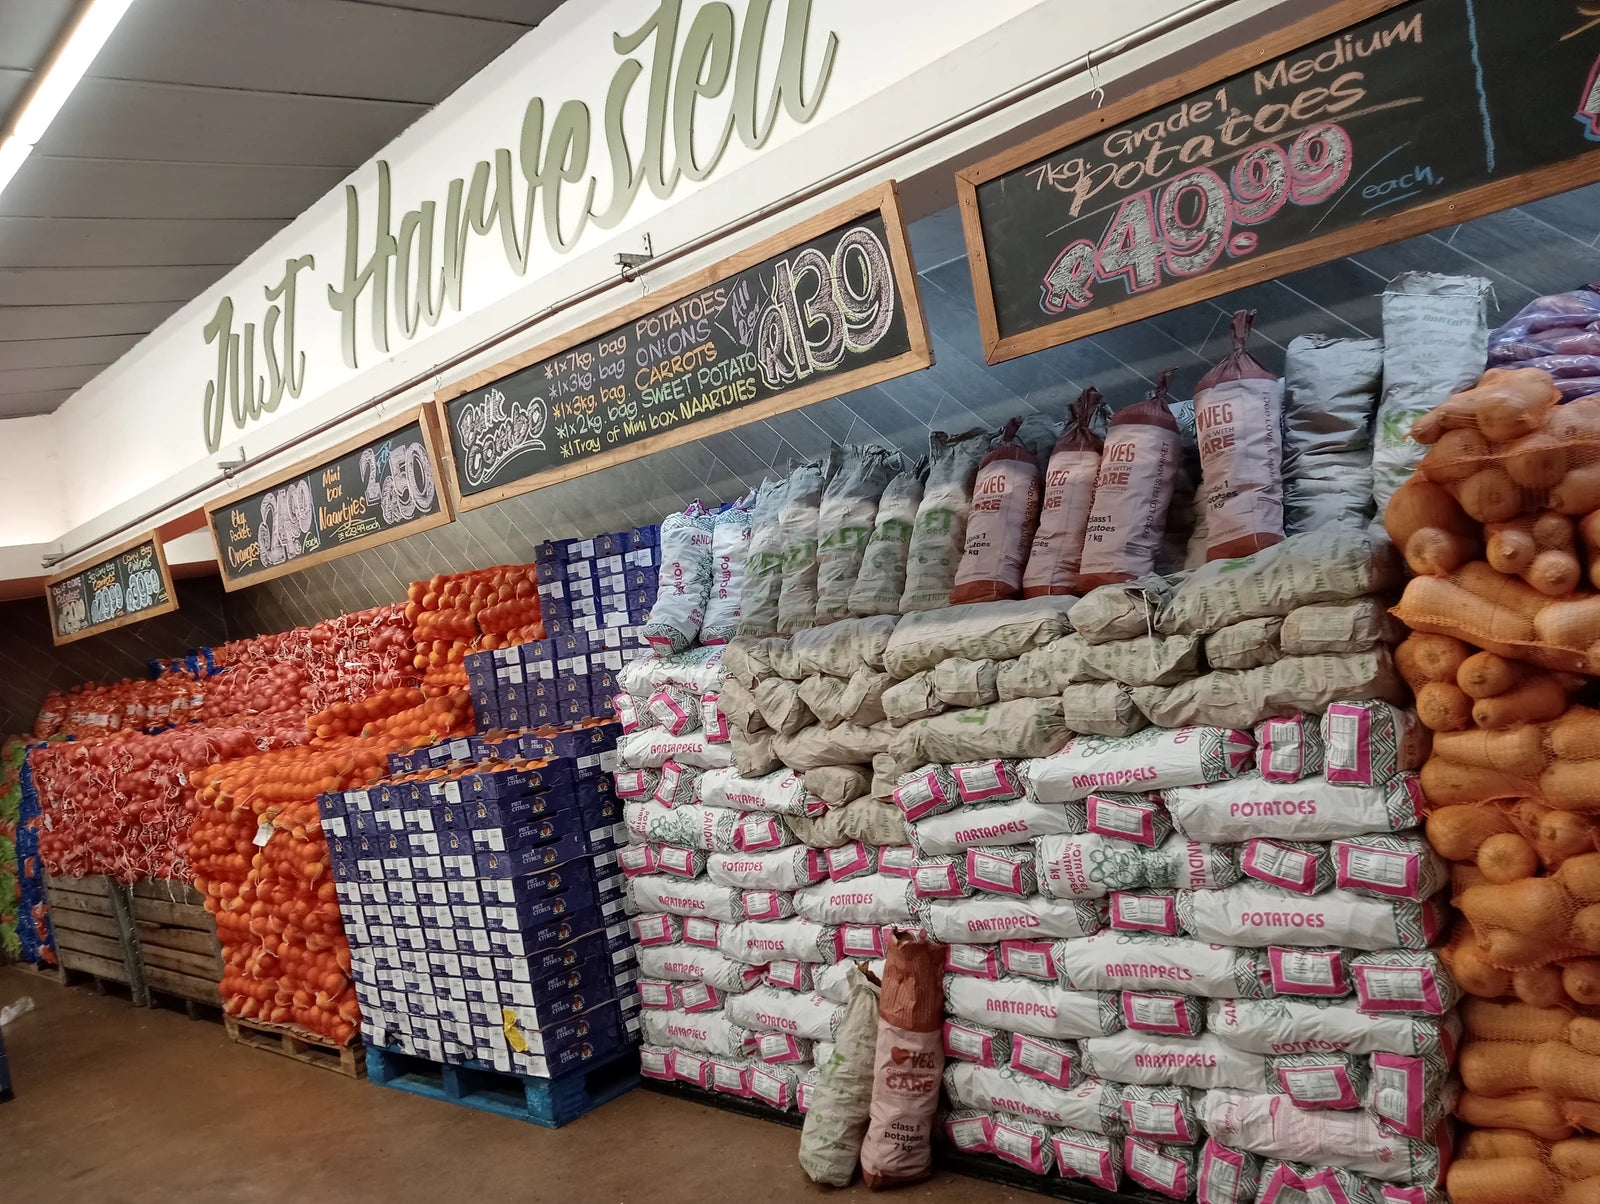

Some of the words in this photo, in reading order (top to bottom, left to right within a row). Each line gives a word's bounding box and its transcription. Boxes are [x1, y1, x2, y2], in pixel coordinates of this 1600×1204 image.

[1253, 13, 1424, 95] Medium
[1039, 122, 1354, 313] R49.99
[757, 226, 895, 390] R139
[598, 335, 627, 357] bag
[635, 287, 728, 341] POTATOES
[203, 254, 315, 454] Just
[599, 358, 626, 380] bag
[634, 341, 718, 391] CARROTS
[607, 401, 638, 422] bag
[641, 373, 692, 409] SWEET
[697, 352, 758, 389] POTATO
[606, 427, 620, 443] of
[624, 413, 647, 438] Mini
[649, 408, 679, 430] box
[679, 377, 757, 420] NAARTJIES
[1204, 403, 1233, 429] VEG
[1110, 443, 1136, 463] VEG
[322, 466, 341, 487] Mini
[359, 448, 382, 506] 2
[380, 442, 435, 525] R50
[983, 475, 1006, 494] VEG
[326, 484, 343, 502] box
[319, 496, 367, 531] Naartjies
[1094, 534, 1103, 542] kg
[228, 542, 260, 567] Oranges
[1072, 766, 1157, 788] AARTAPPELS
[1230, 800, 1317, 817] POTATOES
[955, 820, 1028, 844] AARTAPPELS
[721, 860, 763, 872] POTATOES
[658, 895, 706, 910] AARTAPPELS
[830, 893, 873, 906] POTATOES
[967, 915, 1041, 931] AARTAPPELS
[1241, 912, 1325, 928] POTATOES
[747, 939, 784, 950] POTATOES
[1106, 963, 1193, 981] AARTAPPELS
[986, 998, 1058, 1019] AARTAPPELS
[756, 1013, 797, 1030] POTATOES
[1135, 1053, 1217, 1068] AARTAPPELS
[886, 1075, 934, 1092] CARE
[990, 1096, 1064, 1122] AARTAPPELS
[884, 1131, 924, 1142] potatoes
[891, 1123, 914, 1132] class
